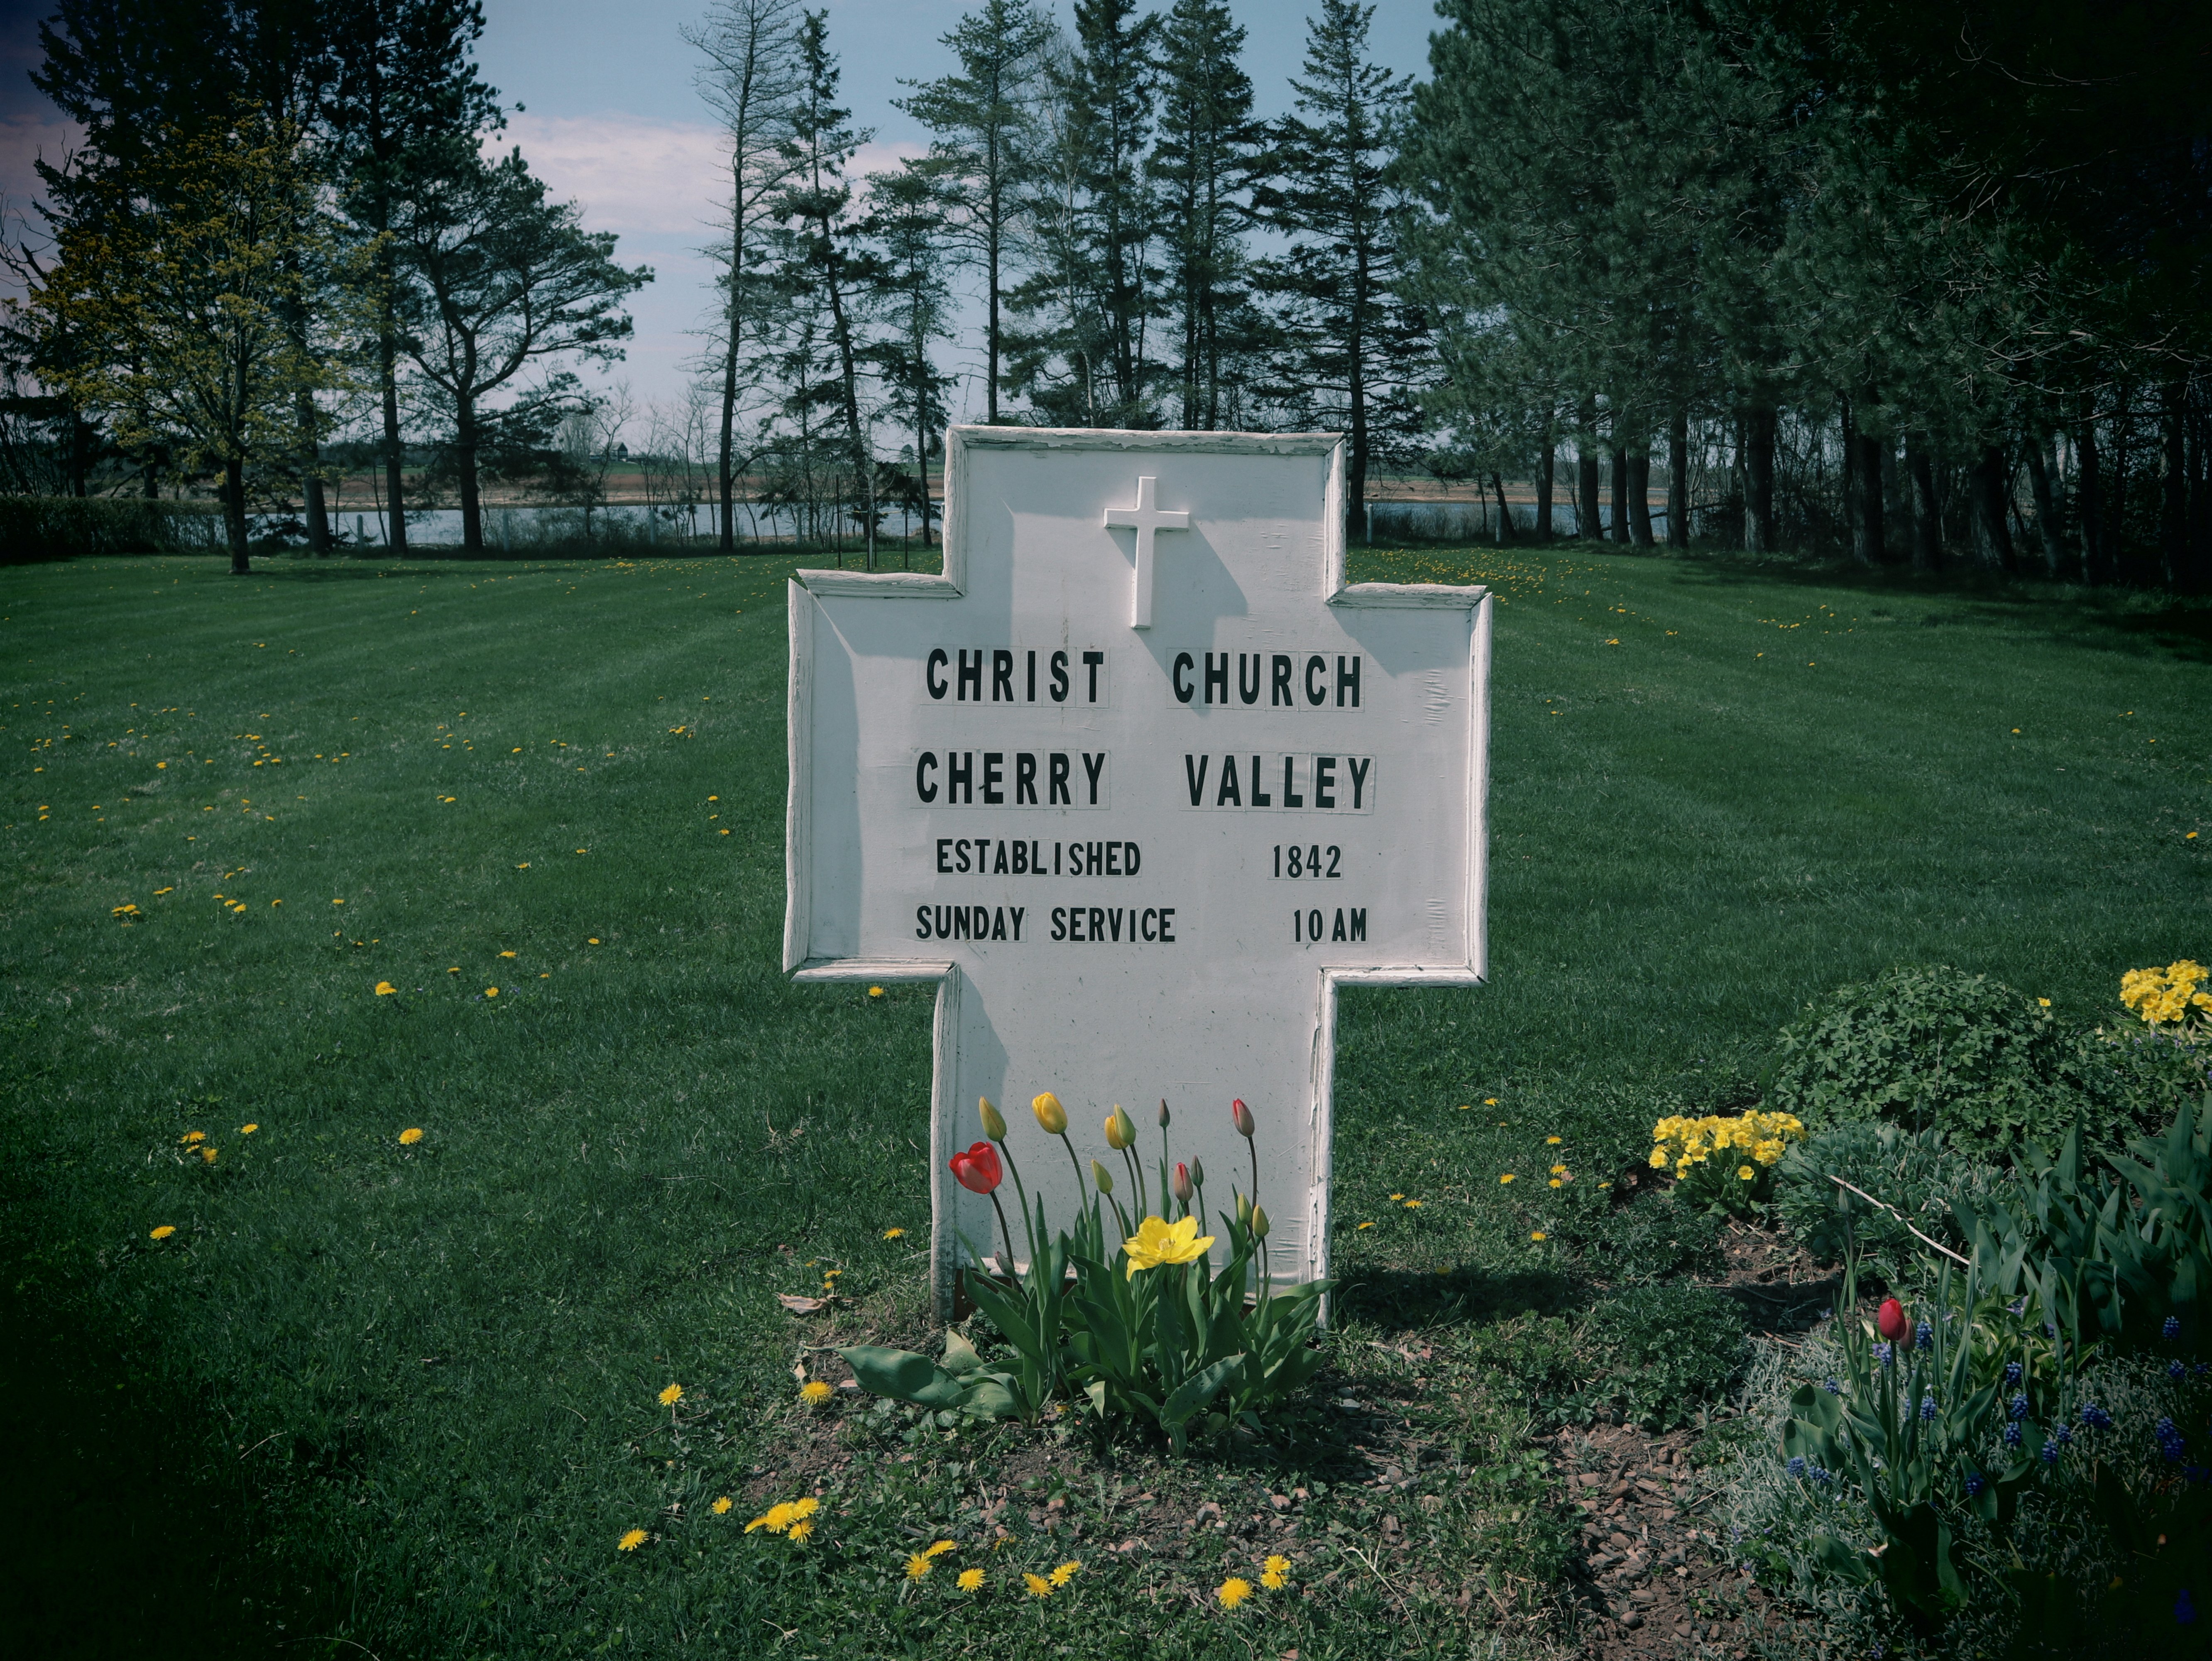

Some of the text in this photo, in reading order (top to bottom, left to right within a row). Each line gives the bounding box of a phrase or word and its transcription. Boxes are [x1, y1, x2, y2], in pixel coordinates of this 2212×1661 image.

[927, 648, 1360, 707] CHRIST CHURCH
[916, 752, 1370, 809] CHERRY VALLEY
[937, 839, 1341, 879] ESTABLISHED 1842
[916, 905, 1025, 941] SUNDAY
[1051, 907, 1175, 942] SERVICE
